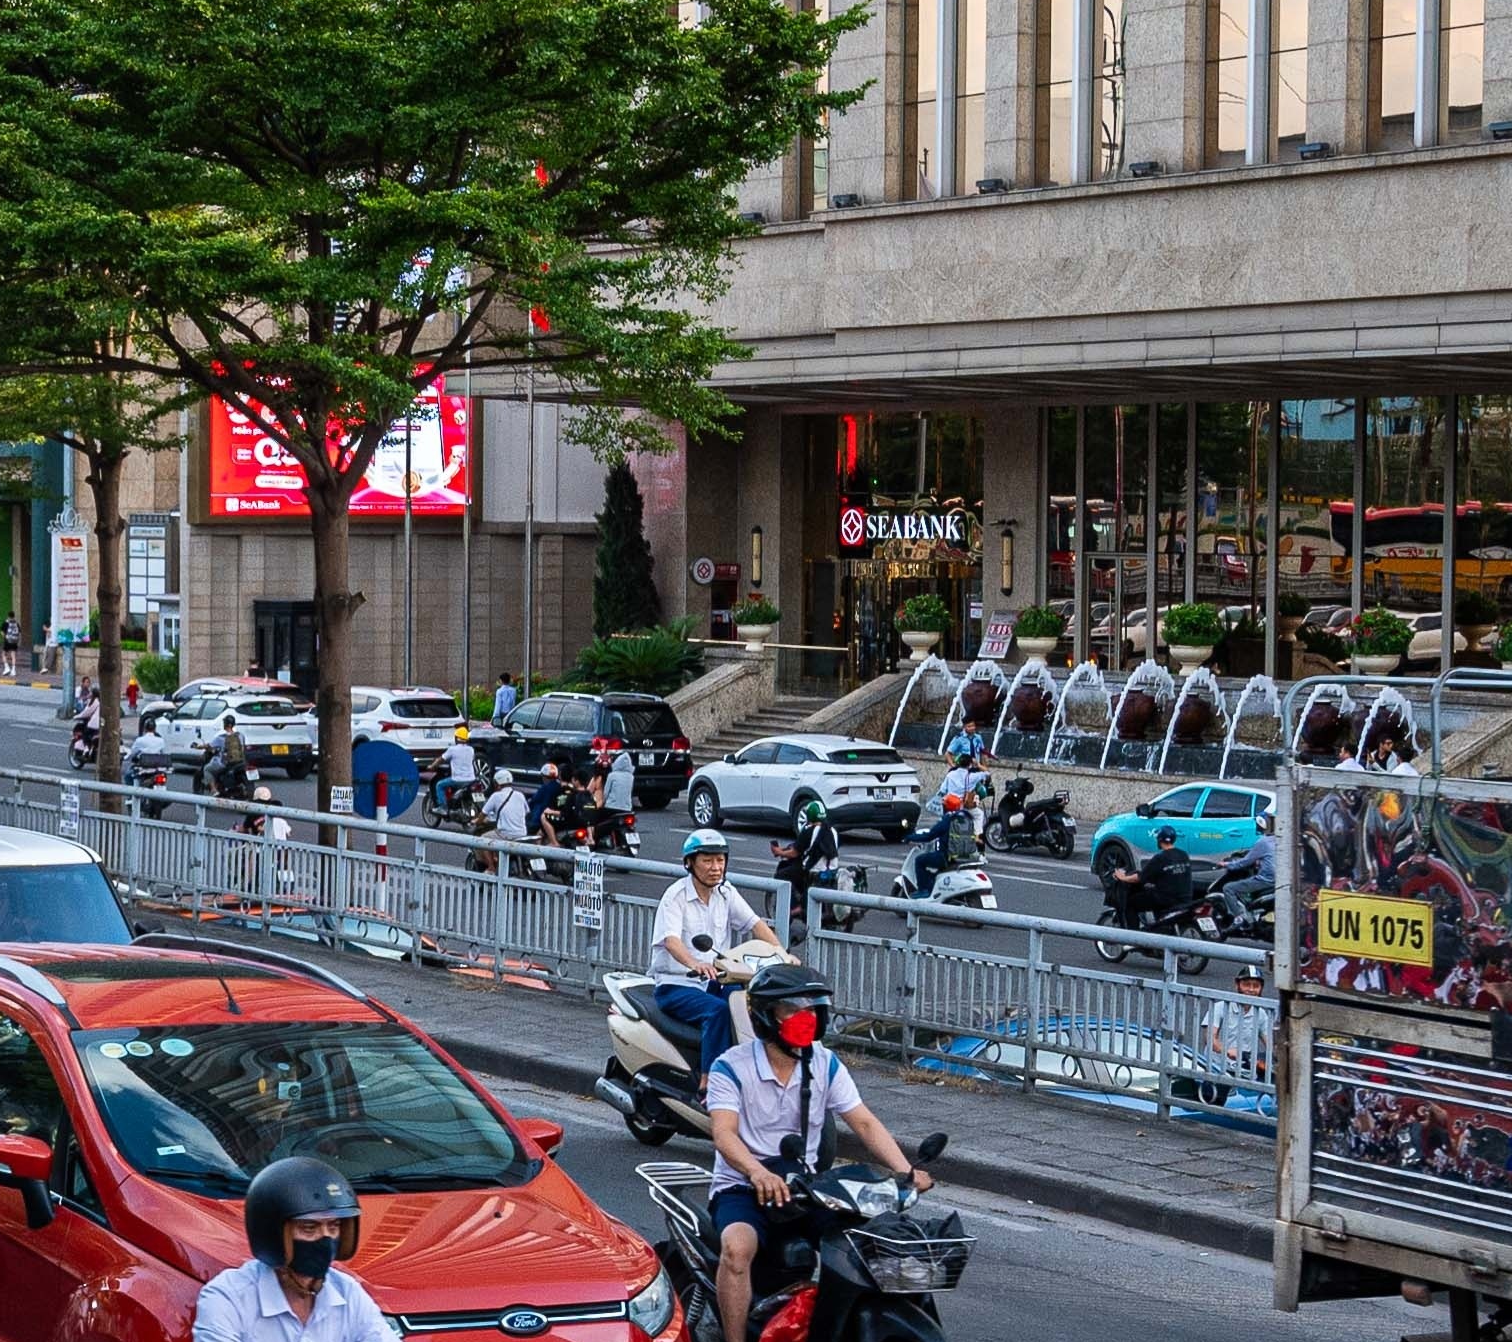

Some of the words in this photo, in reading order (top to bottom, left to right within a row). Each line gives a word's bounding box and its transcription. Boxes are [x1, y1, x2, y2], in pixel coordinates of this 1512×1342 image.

[239, 500, 281, 510] SeABank
[866, 514, 961, 540] SEABANK
[1328, 908, 1360, 941] UN
[1370, 914, 1424, 949] 1075
[513, 1315, 538, 1328] Ford
